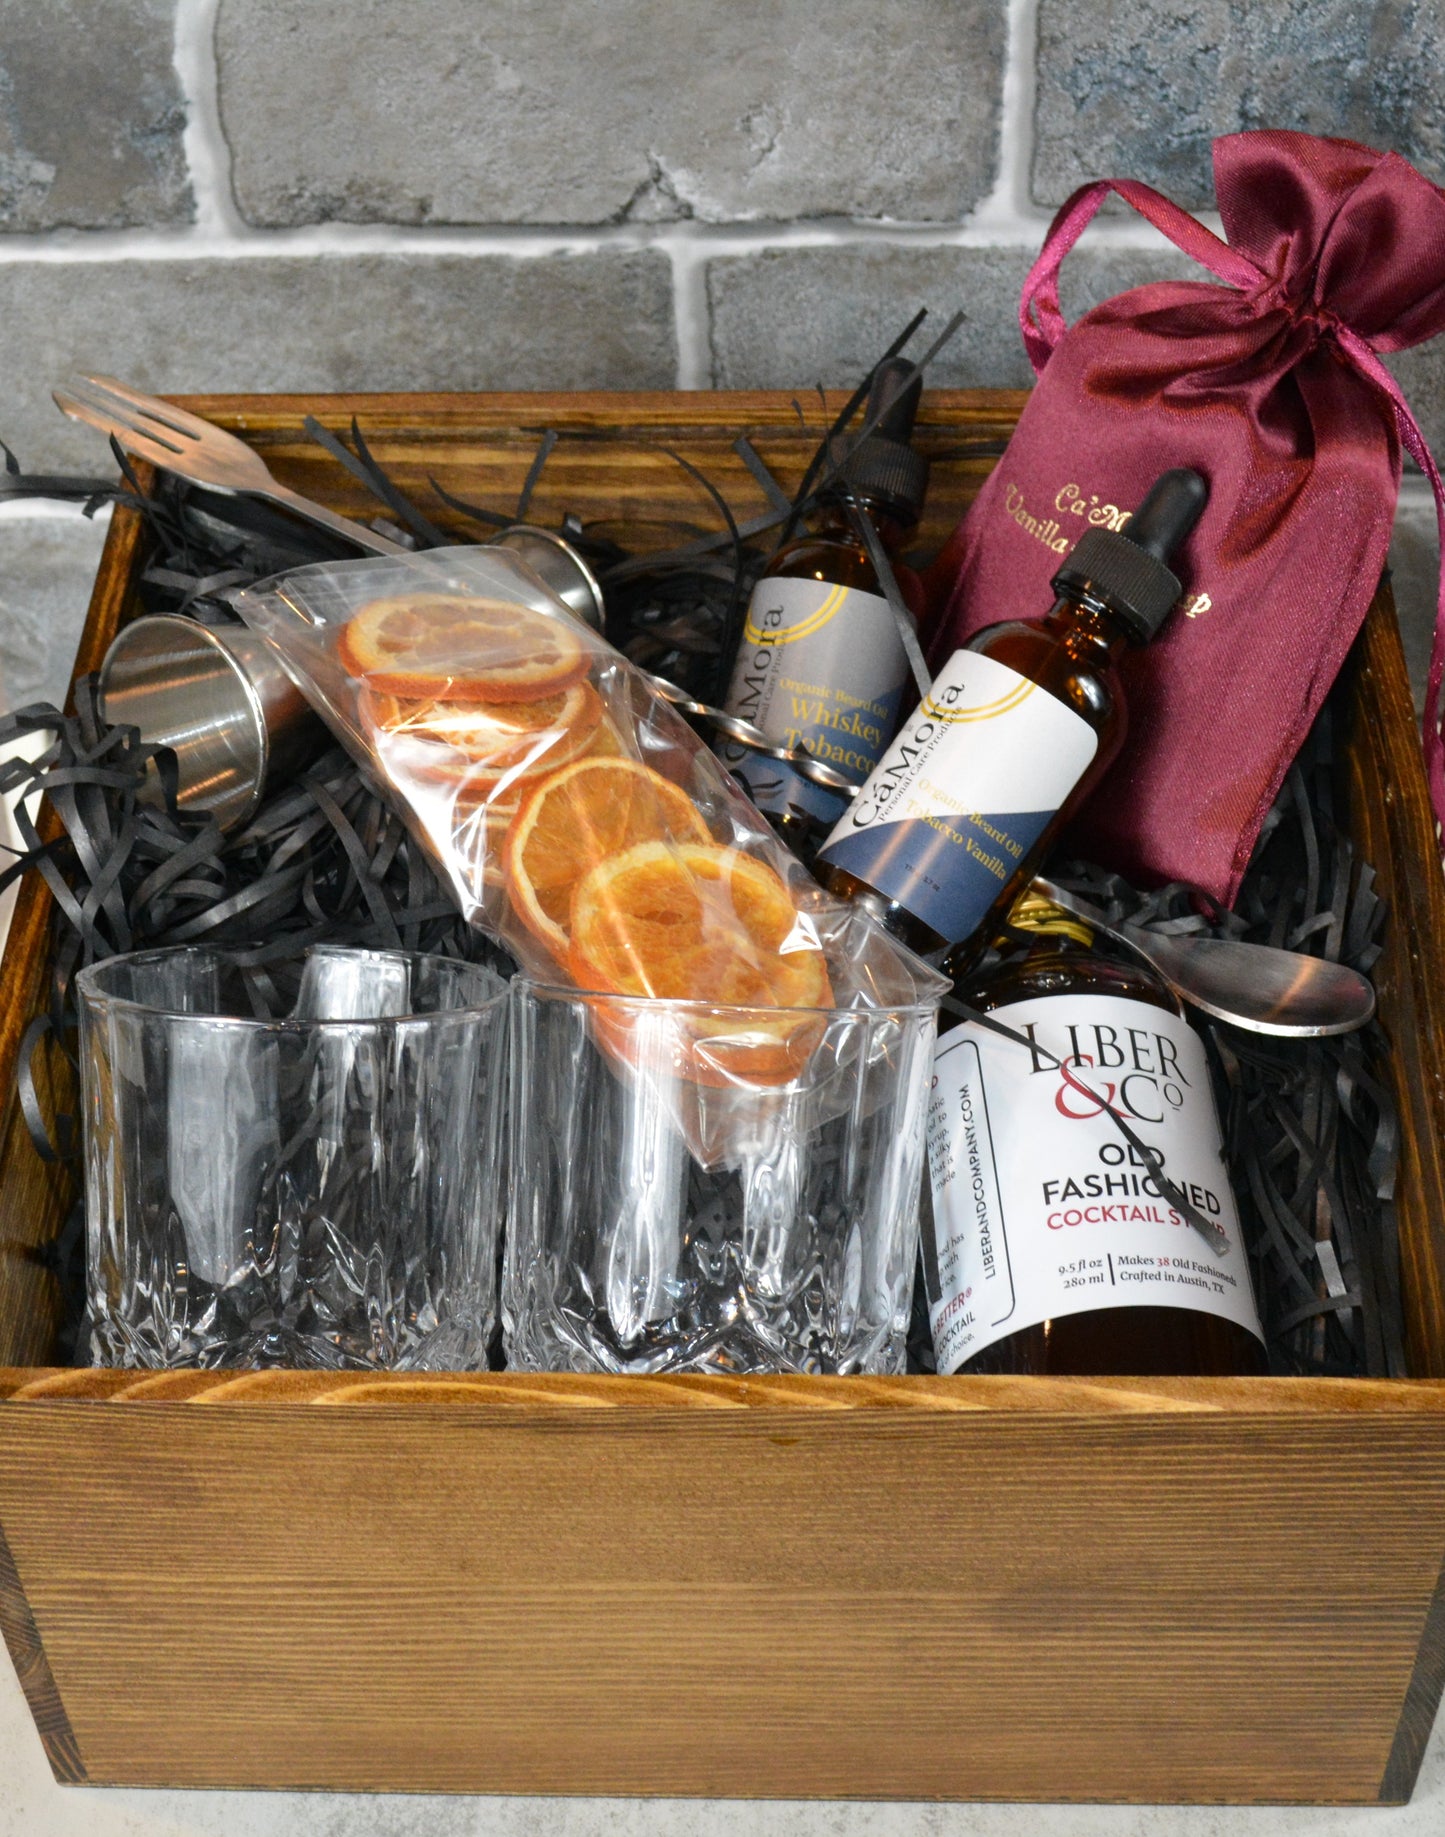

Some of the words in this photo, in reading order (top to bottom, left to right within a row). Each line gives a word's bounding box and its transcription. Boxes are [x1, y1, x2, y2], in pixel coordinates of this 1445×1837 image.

[1005, 483, 1069, 554] Vanilla
[779, 678, 833, 699] Organic
[836, 688, 873, 711] Beard
[791, 696, 883, 749] Whiskey
[785, 727, 877, 773] Tobacco
[878, 776, 913, 823] Personal
[910, 751, 929, 777] Care
[928, 706, 963, 751] Products
[906, 799, 964, 845] Tobacco
[964, 837, 1008, 881] Vanilla
[918, 778, 971, 816] Organic
[969, 811, 1007, 847] Beard
[1005, 839, 1024, 859] Oil
[1020, 1022, 1193, 1088] LIBER
[958, 1083, 995, 1280] LIBERANDCOMPANY.COM
[1046, 1205, 1165, 1231] COCKTAIL
[1058, 1263, 1076, 1276] 9.5
[1078, 1259, 1087, 1275] fl
[1089, 1259, 1103, 1268] oz
[1063, 1277, 1086, 1290] 280
[1088, 1273, 1104, 1285] ml
[1117, 1255, 1155, 1266] Makes
[1156, 1257, 1170, 1267] 38
[1172, 1258, 1190, 1270] Old
[1191, 1261, 1237, 1288] Fashioneds
[1120, 1269, 1162, 1282] Crafted
[1164, 1271, 1175, 1283] in
[1177, 1273, 1212, 1291] Austin,
[1211, 1281, 1226, 1295] TX
